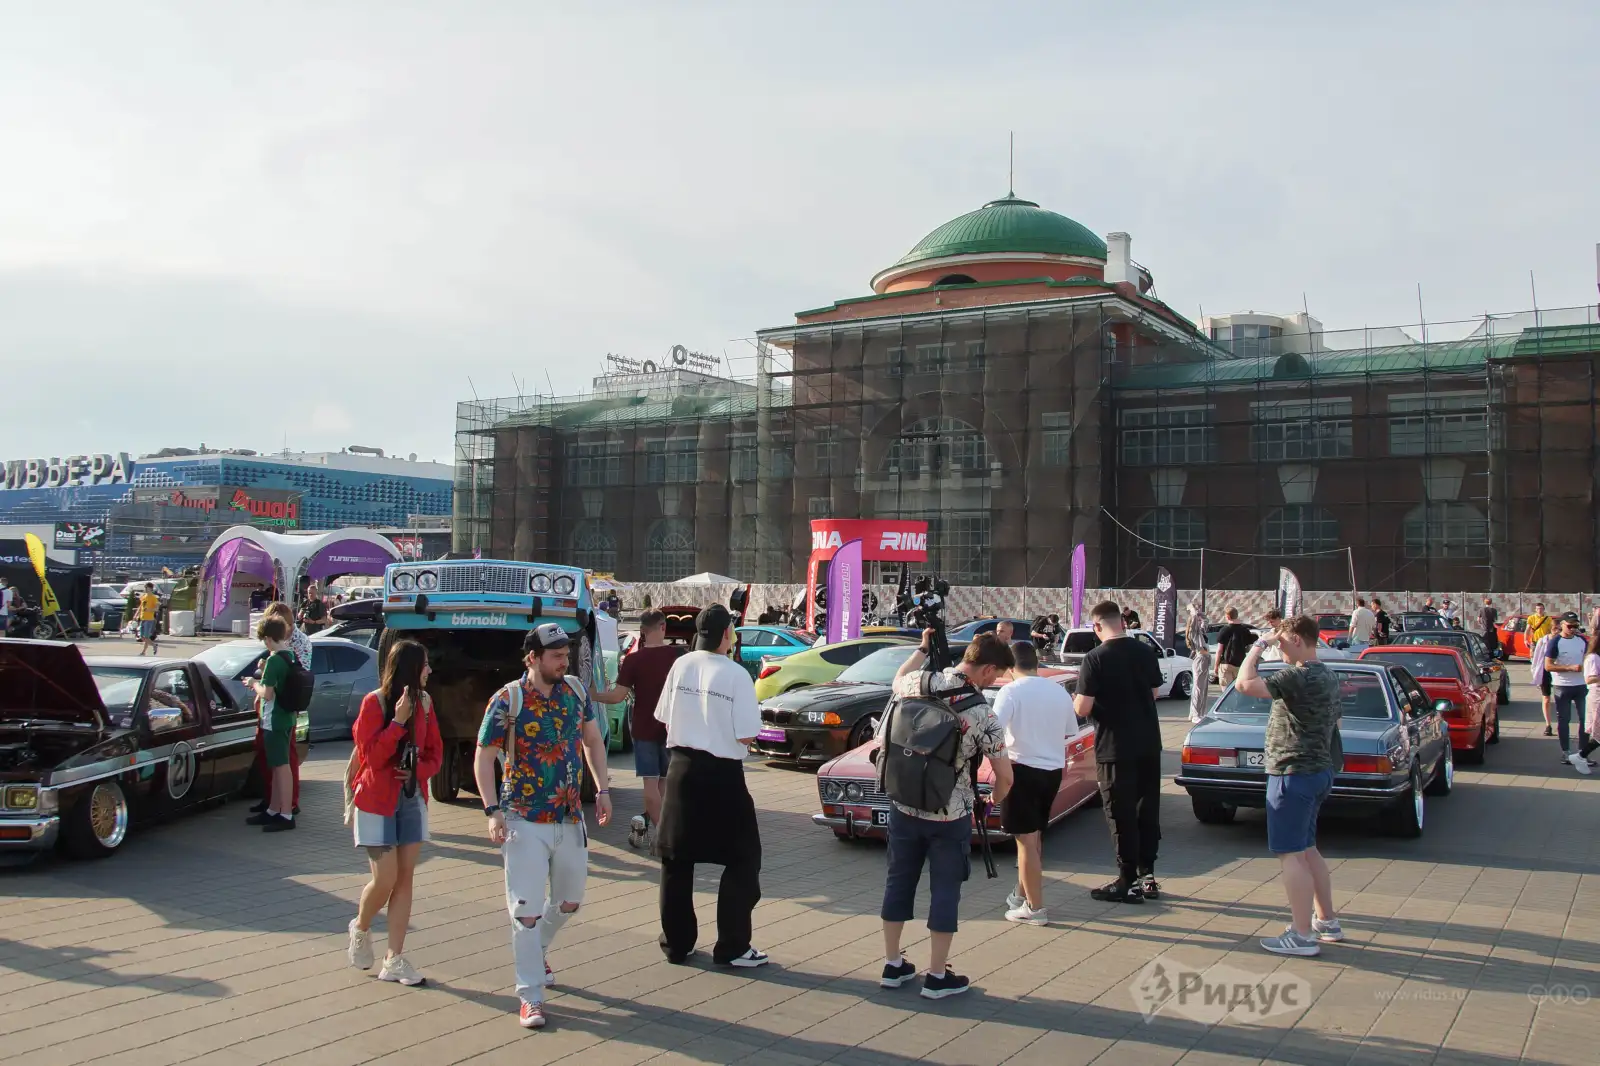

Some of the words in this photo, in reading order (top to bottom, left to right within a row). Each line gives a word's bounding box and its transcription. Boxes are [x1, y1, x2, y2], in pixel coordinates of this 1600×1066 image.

[0, 452, 134, 490] ИВЬЕРА
[451, 612, 507, 626] bbmobil
[173, 752, 189, 787] 21
